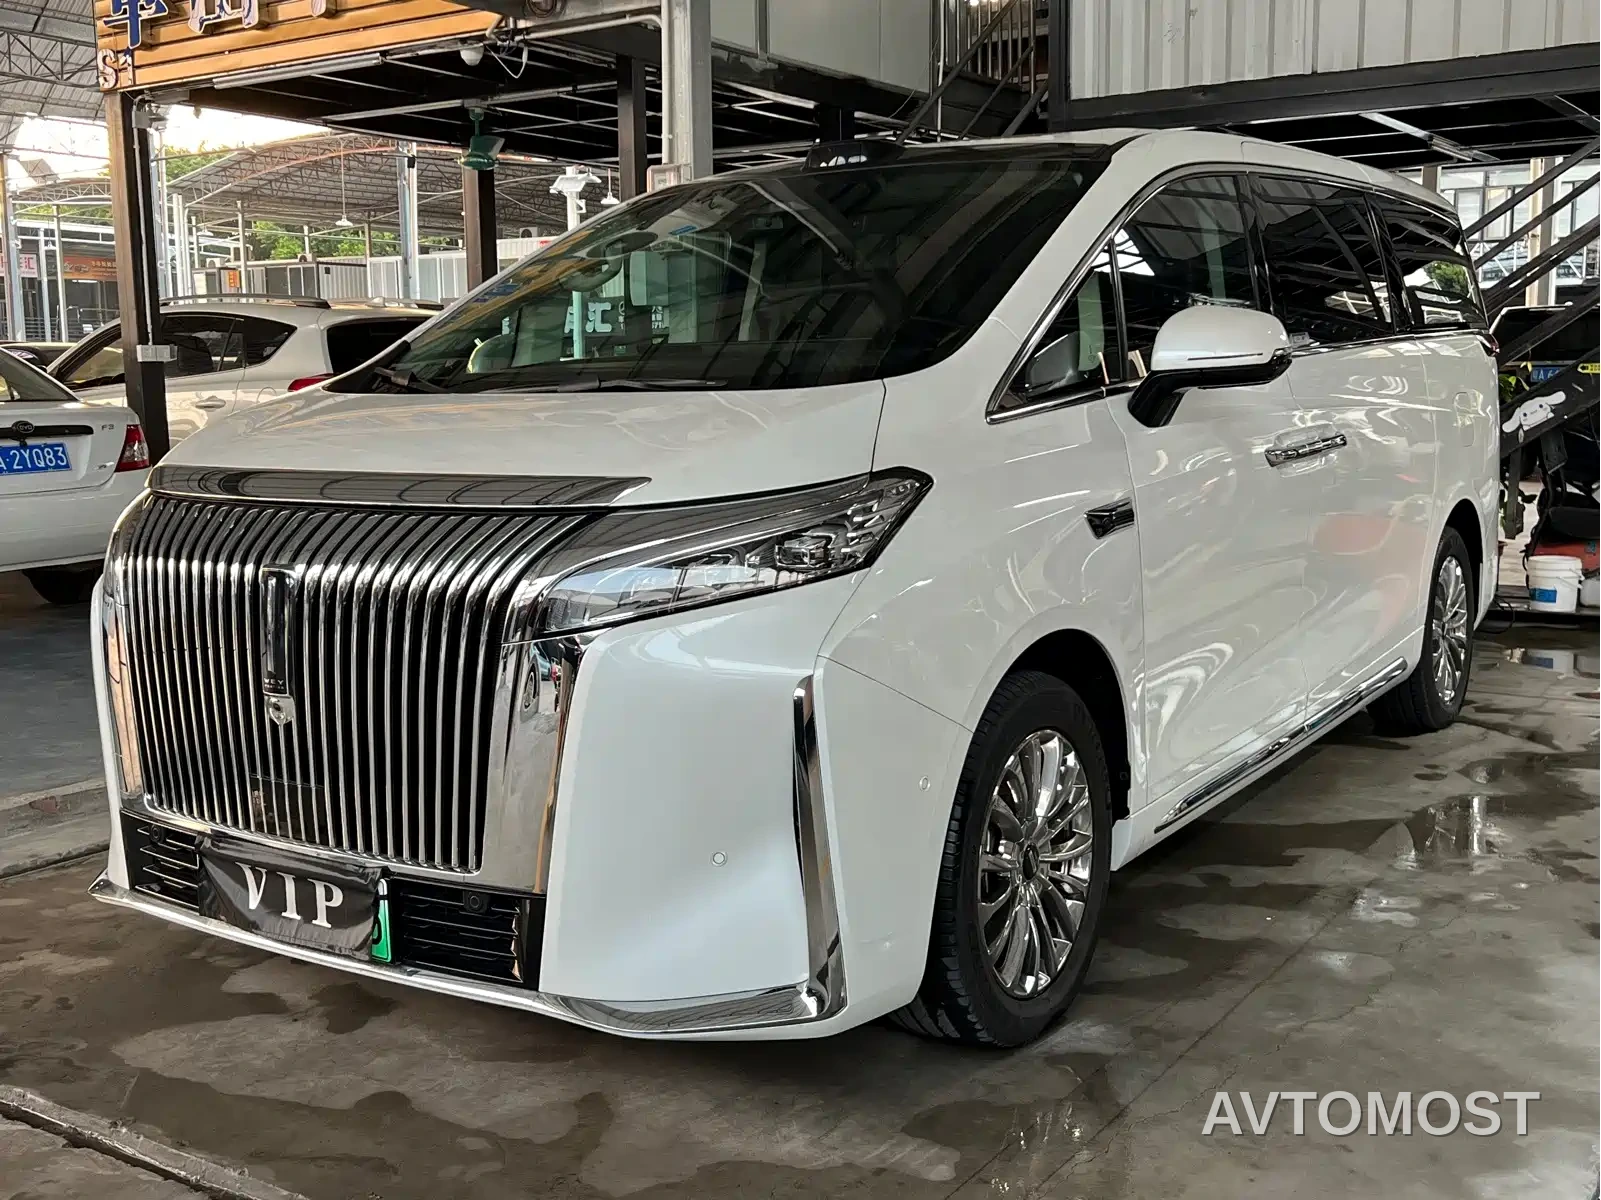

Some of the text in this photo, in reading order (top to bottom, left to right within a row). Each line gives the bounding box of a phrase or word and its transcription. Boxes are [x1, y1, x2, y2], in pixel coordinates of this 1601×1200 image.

[97, 48, 133, 88] S1
[101, 423, 115, 431] F3
[235, 861, 344, 928] VIP
